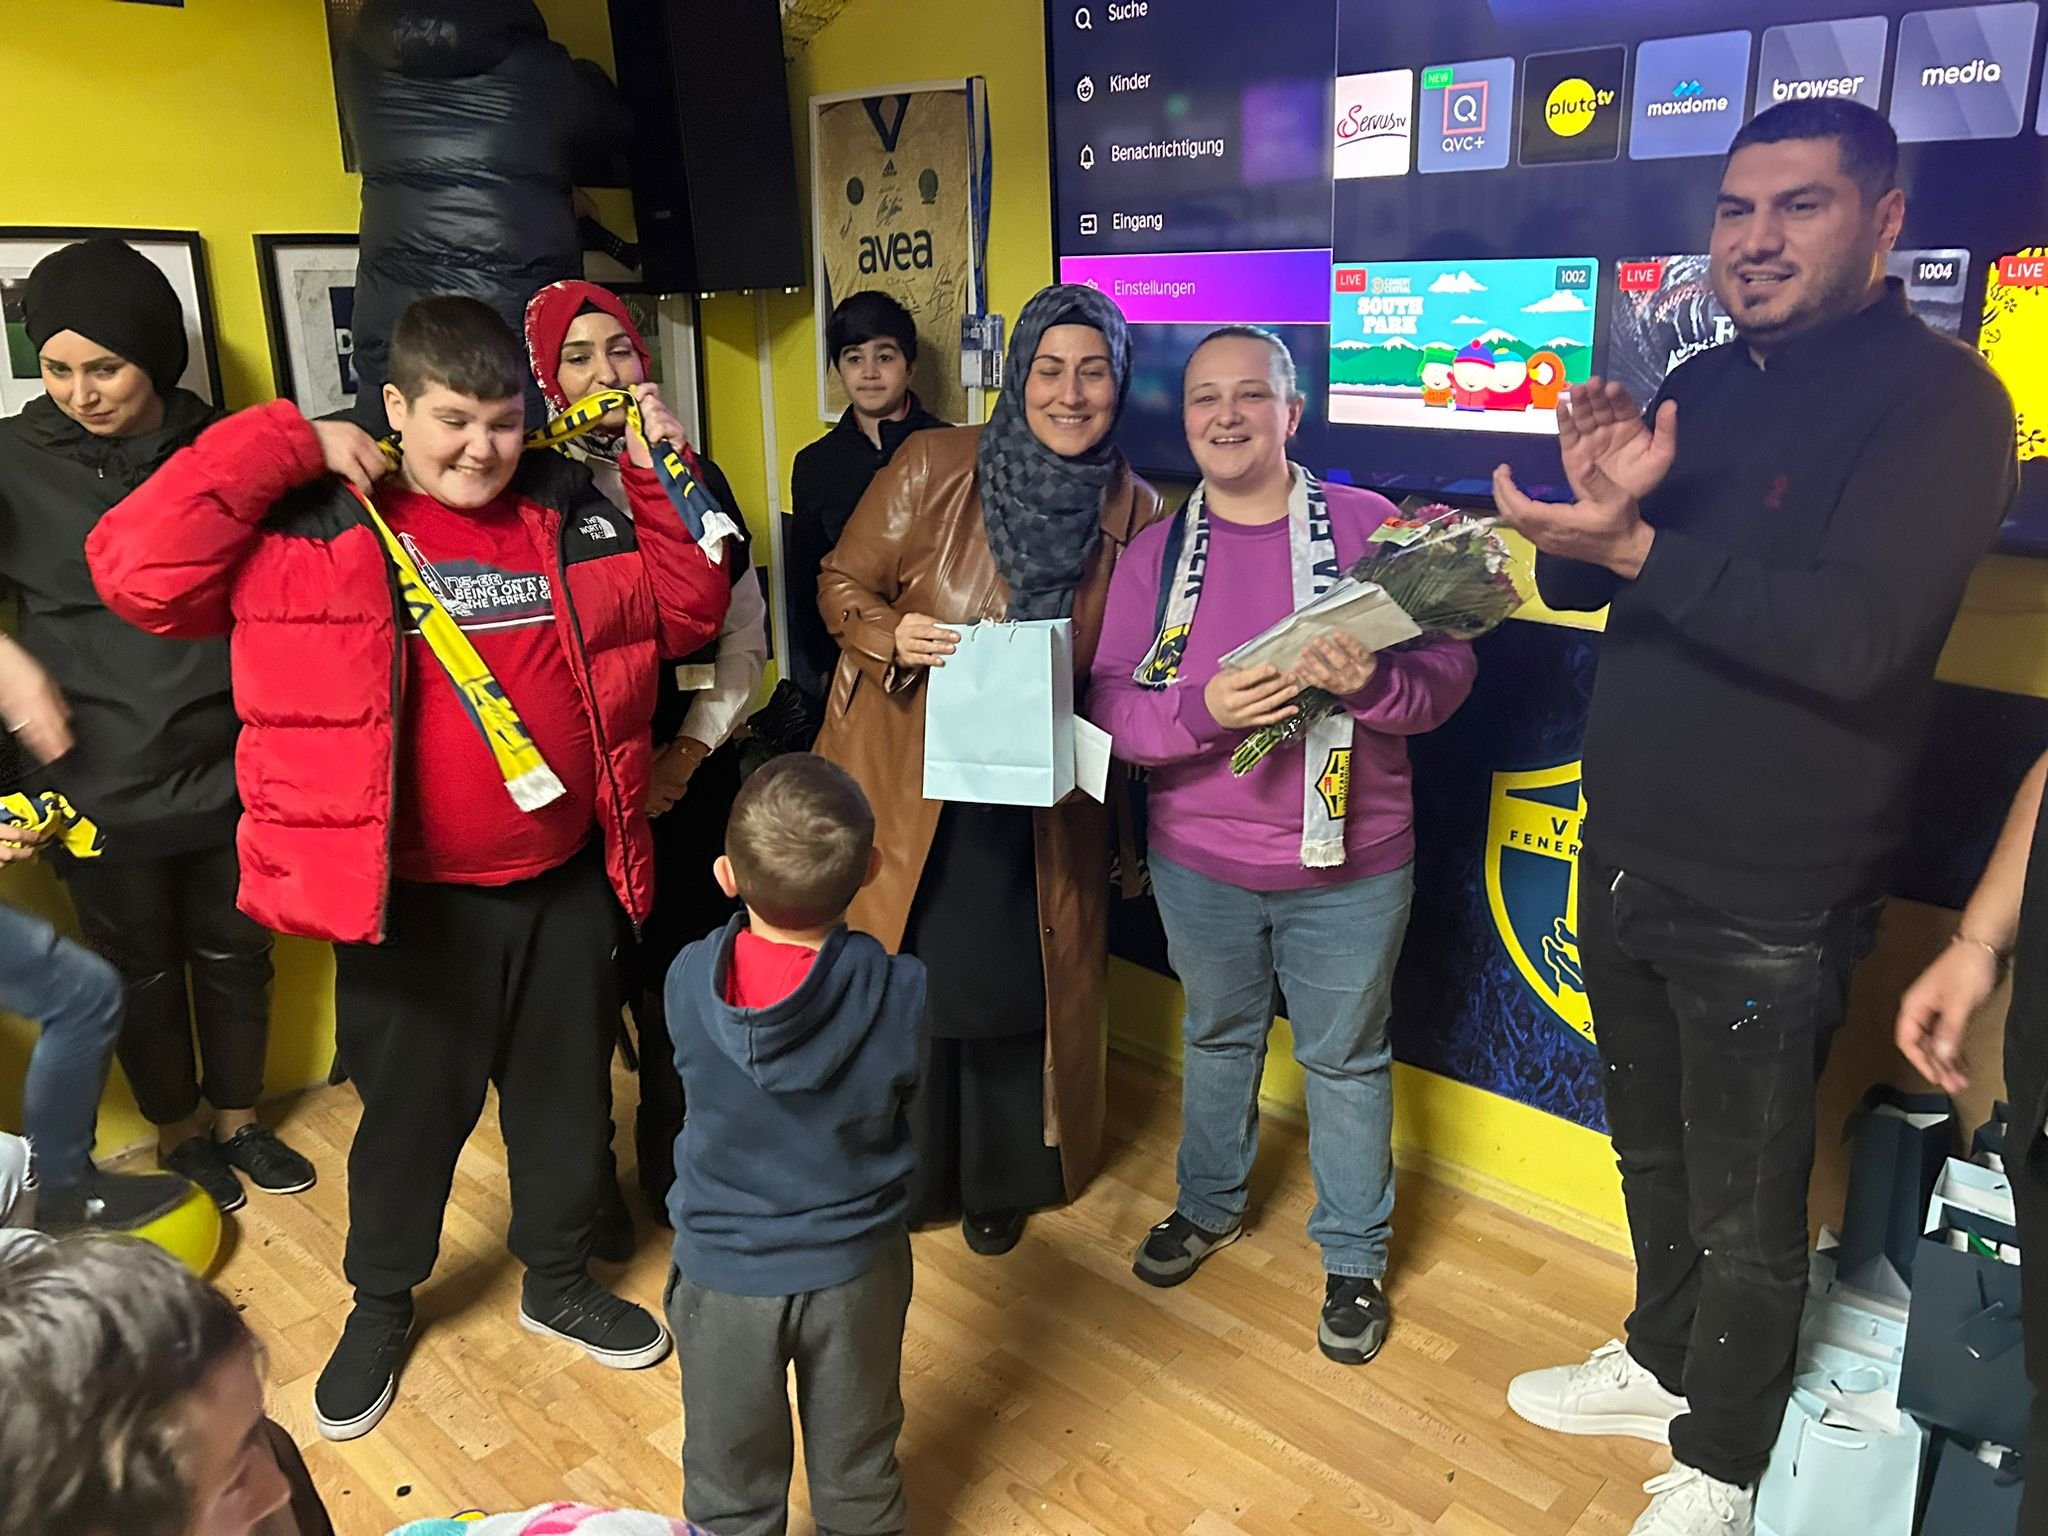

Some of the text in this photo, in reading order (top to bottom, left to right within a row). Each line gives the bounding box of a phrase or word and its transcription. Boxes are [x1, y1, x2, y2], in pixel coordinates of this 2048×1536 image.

[1108, 0, 1148, 21] Suche
[1428, 73, 1449, 83] NEW
[1921, 59, 2001, 86] media
[1110, 73, 1151, 92] Kinder
[1772, 76, 1865, 99] browser
[1647, 96, 1728, 116] maxdome
[1111, 138, 1224, 162] Benachrichtigung
[1113, 213, 1163, 231] Eingang
[858, 229, 933, 275] avea
[1561, 270, 1586, 284] 1002
[1627, 269, 1655, 283] LIVE
[1919, 263, 1953, 280] 1004
[2007, 263, 2044, 278] LIVE
[1114, 280, 1195, 298] Einstellungen
[1340, 274, 1362, 286] LIVE
[1357, 296, 1424, 315] SOUTH
[1363, 316, 1418, 334] PARK
[454, 586, 498, 601] BEING
[501, 580, 523, 596] ON
[526, 578, 538, 593] A
[467, 599, 490, 610] THE
[492, 592, 537, 607] PERFECT
[1509, 829, 1581, 856] FENER
